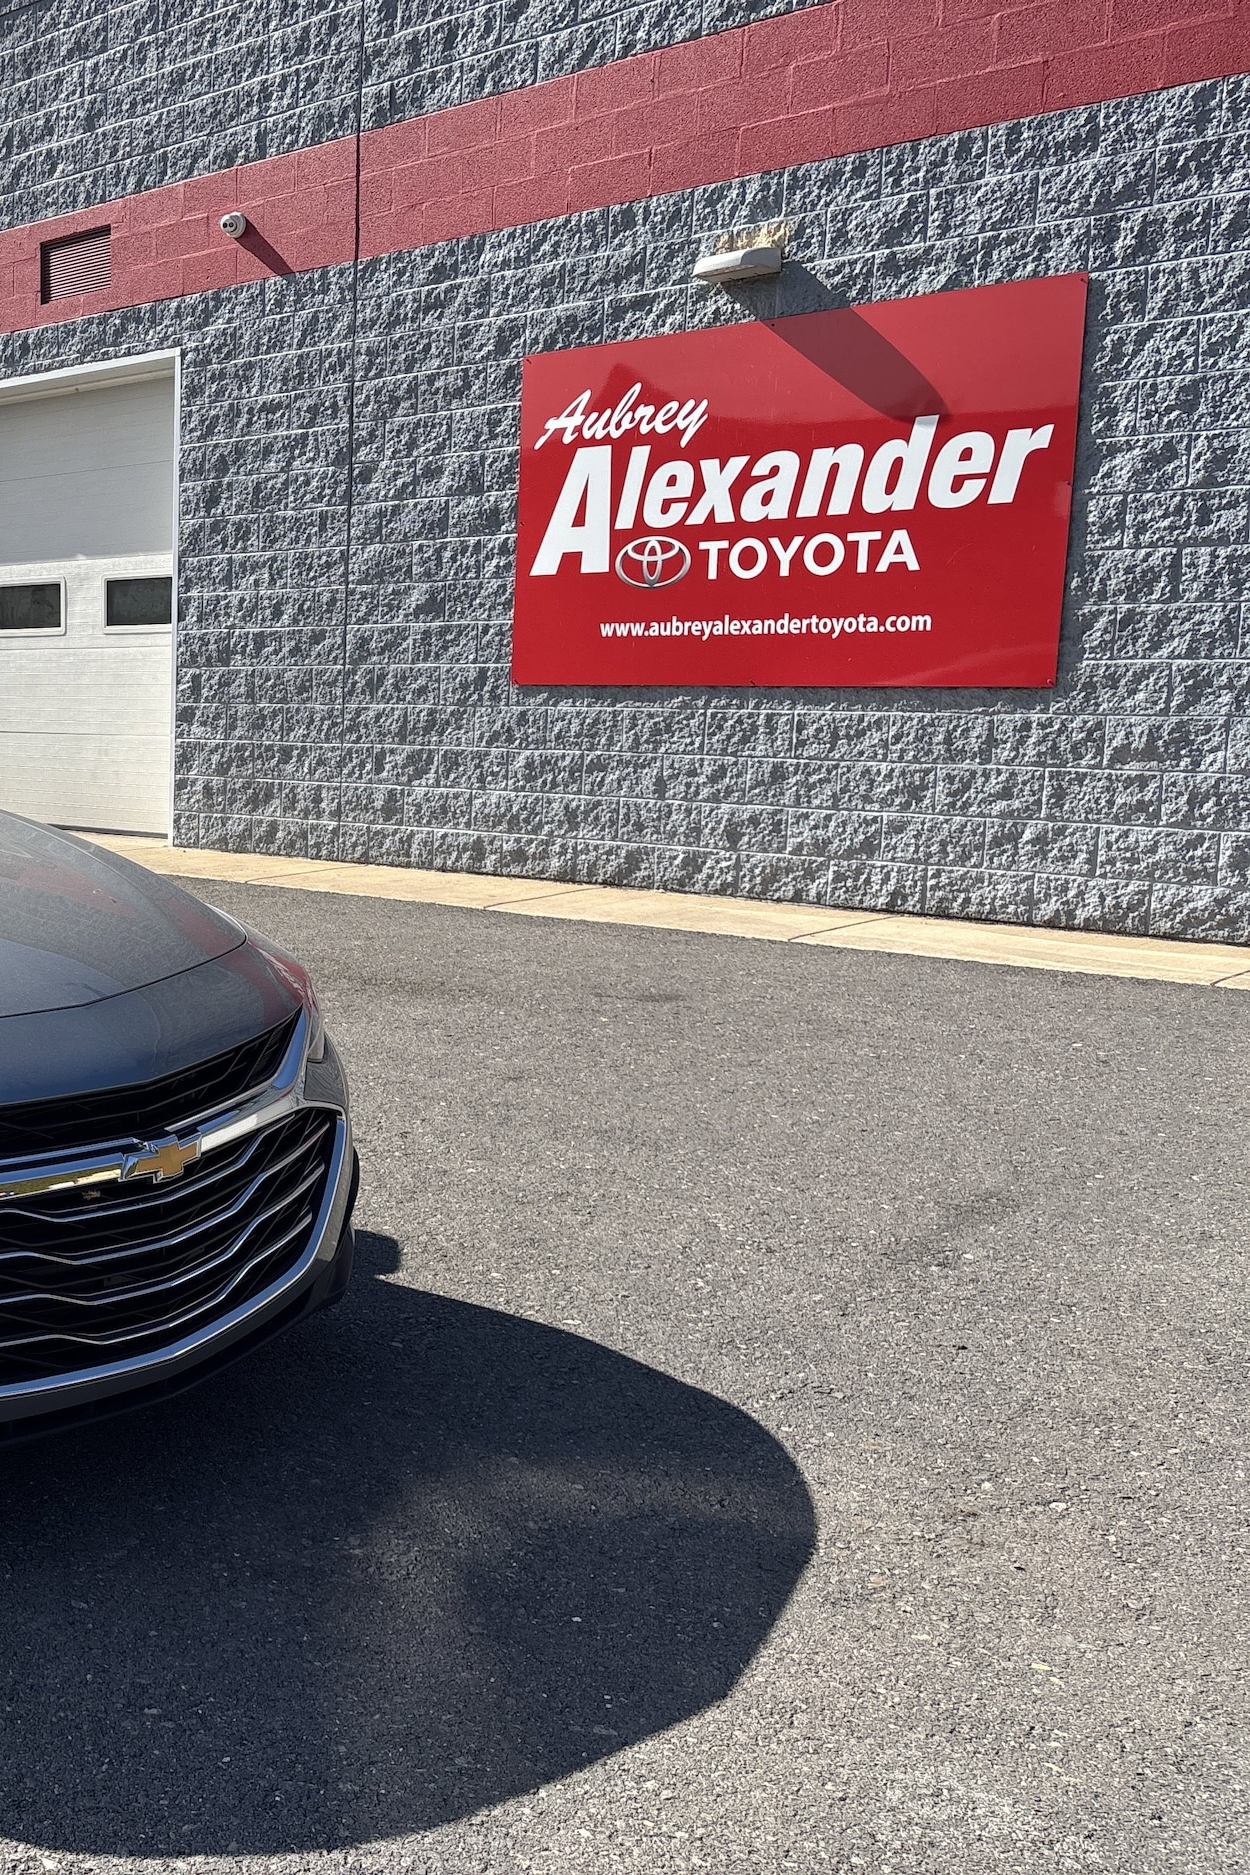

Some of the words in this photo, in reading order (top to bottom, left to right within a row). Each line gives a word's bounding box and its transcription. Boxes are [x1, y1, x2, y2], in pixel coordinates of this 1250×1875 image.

[533, 382, 709, 450] Aubrey
[529, 414, 1055, 577] Alexander
[698, 529, 921, 580] TOYOTA
[599, 612, 932, 641] www.aubreyalexandertoyota.com
